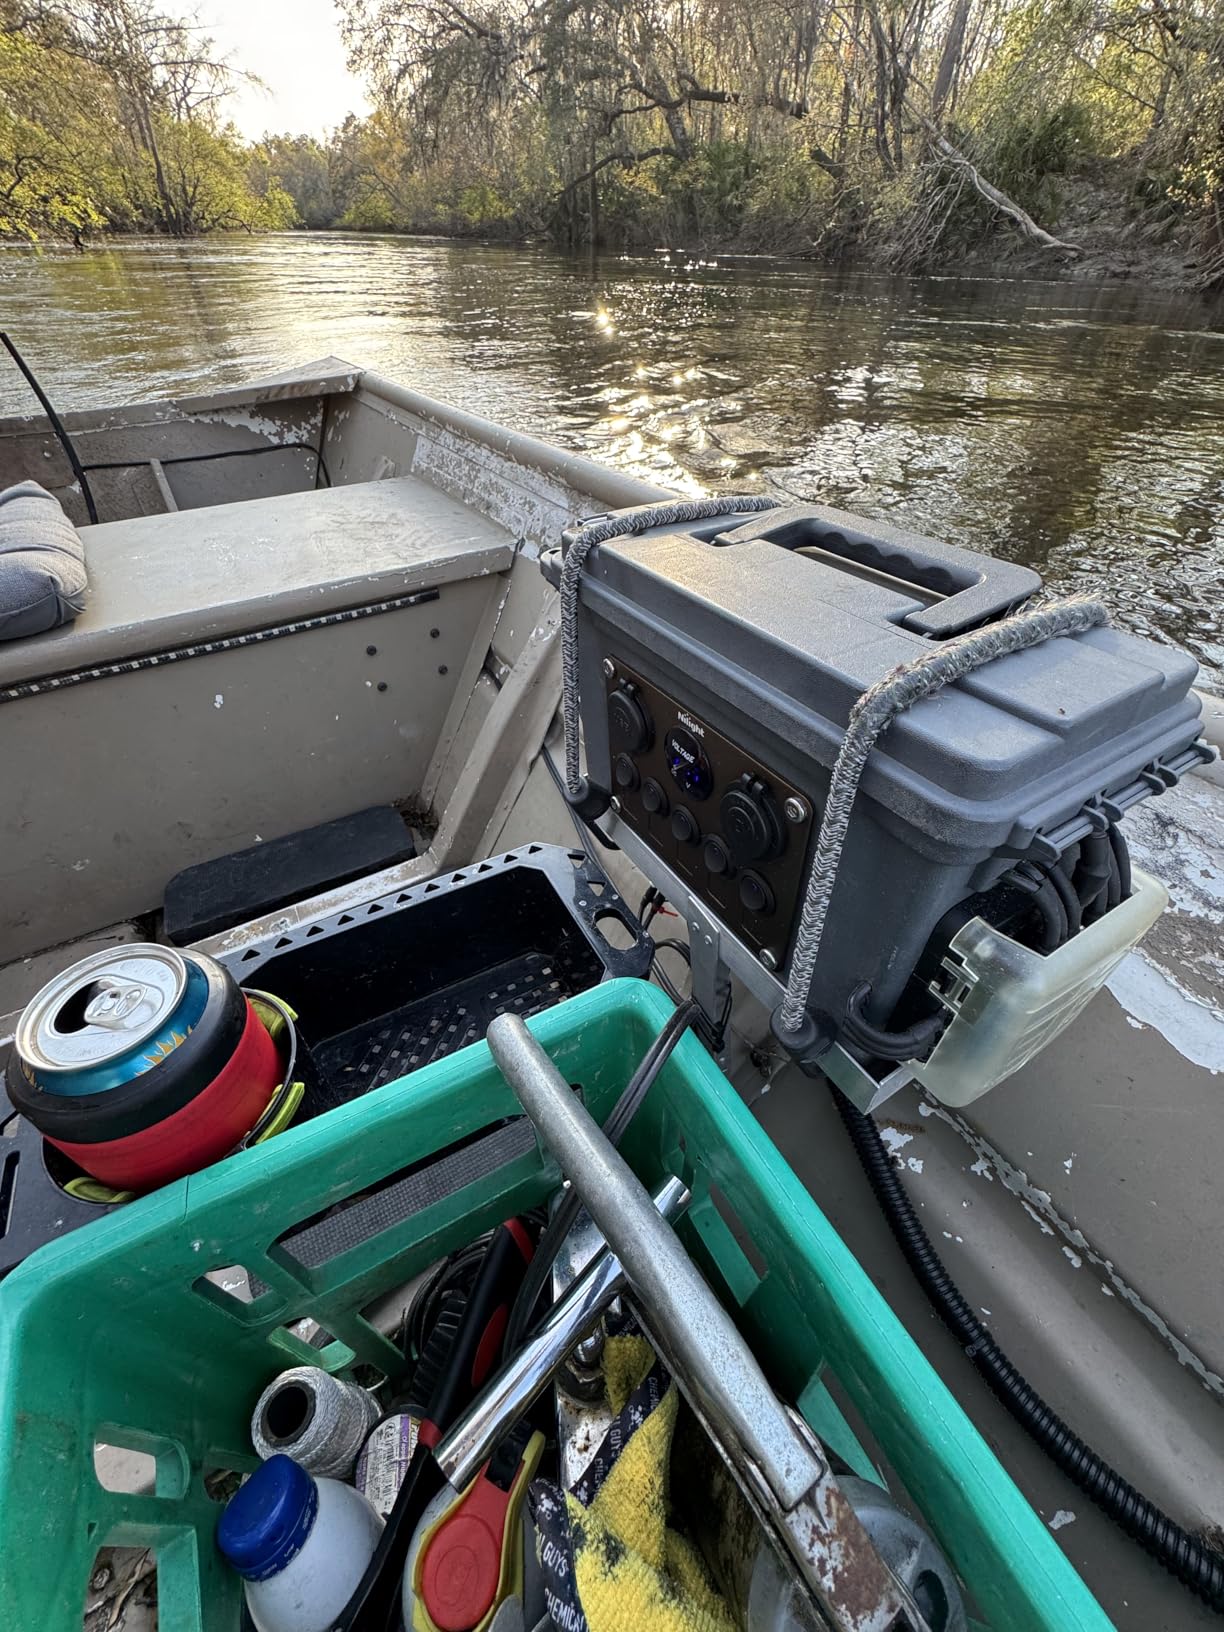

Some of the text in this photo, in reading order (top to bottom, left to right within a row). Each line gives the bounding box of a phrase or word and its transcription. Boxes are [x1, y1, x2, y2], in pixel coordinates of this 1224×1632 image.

[677, 711, 705, 738] Nilight
[671, 739, 696, 764] VOLTAGE
[543, 1541, 568, 1577] GUYS
